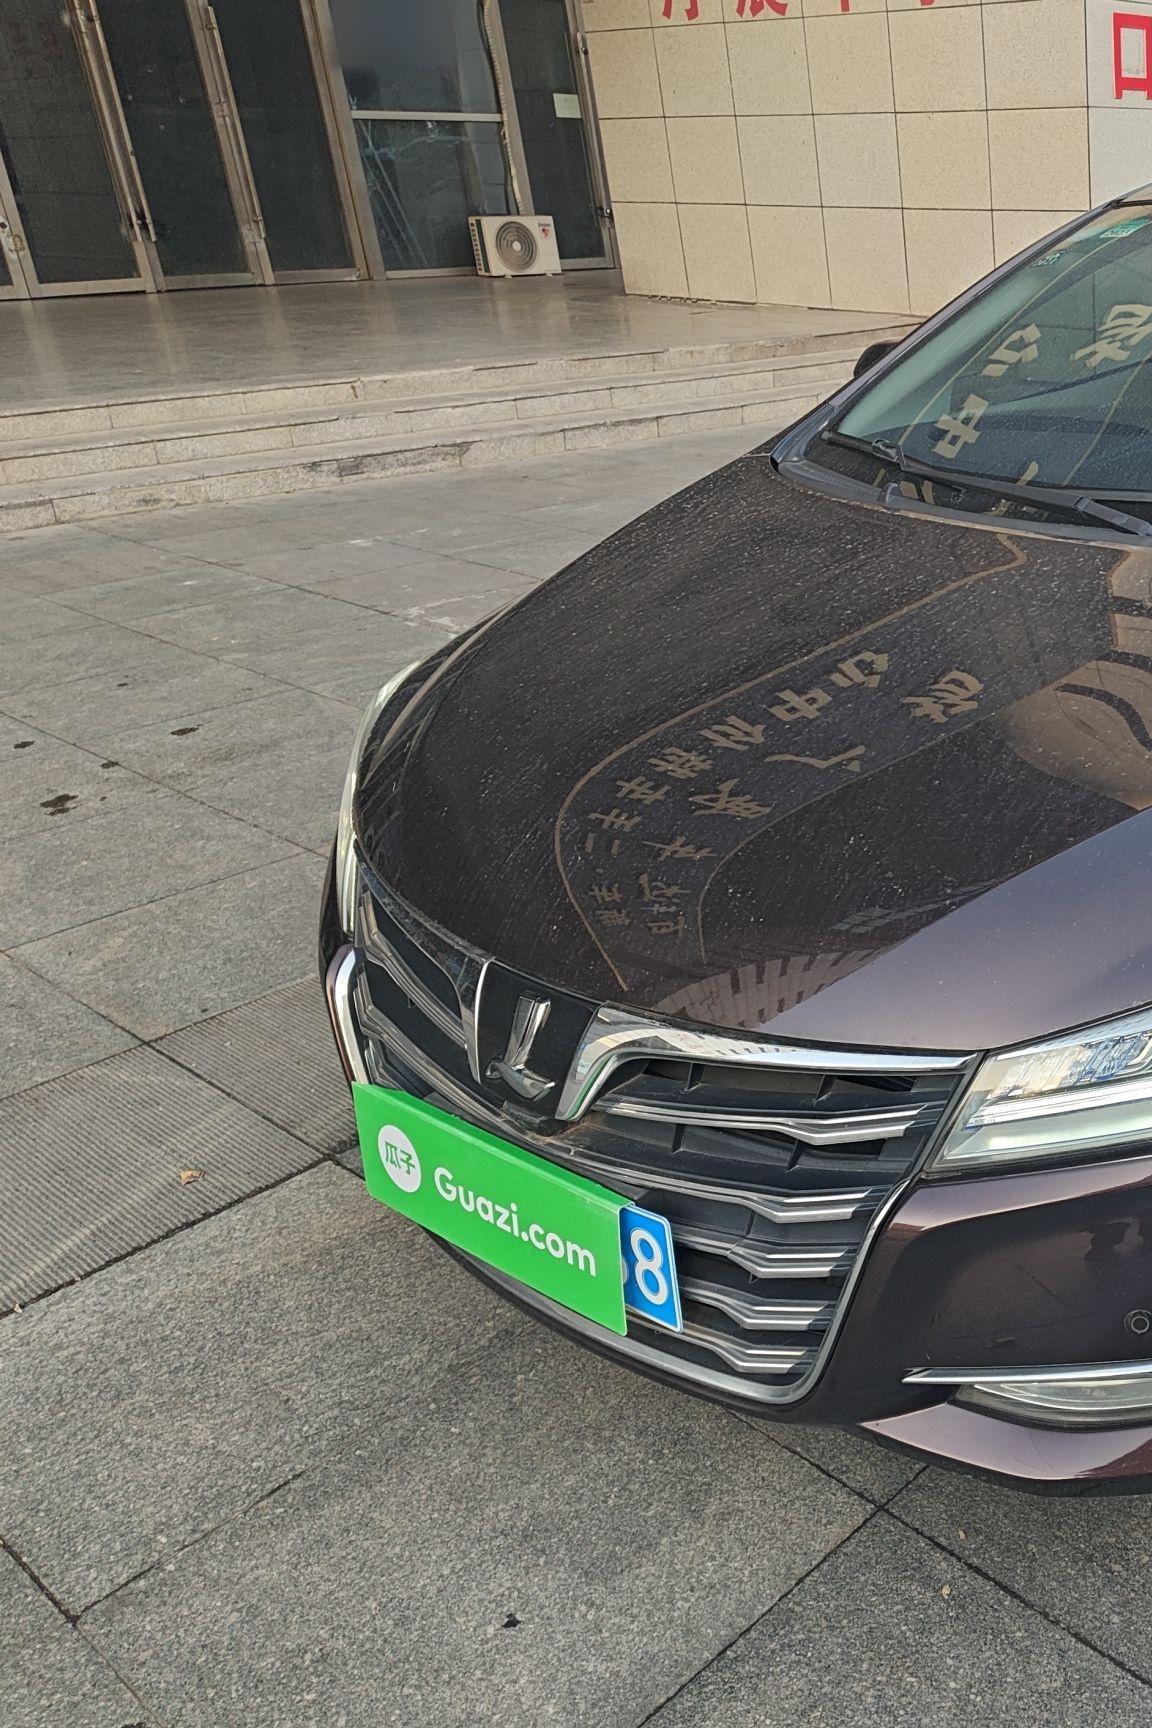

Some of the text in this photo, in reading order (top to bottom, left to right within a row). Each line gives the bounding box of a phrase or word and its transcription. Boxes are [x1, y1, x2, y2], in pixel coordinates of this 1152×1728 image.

[384, 1140, 416, 1176] 瓜子
[434, 1166, 597, 1278] Guazi.com
[622, 1227, 669, 1306] 8
